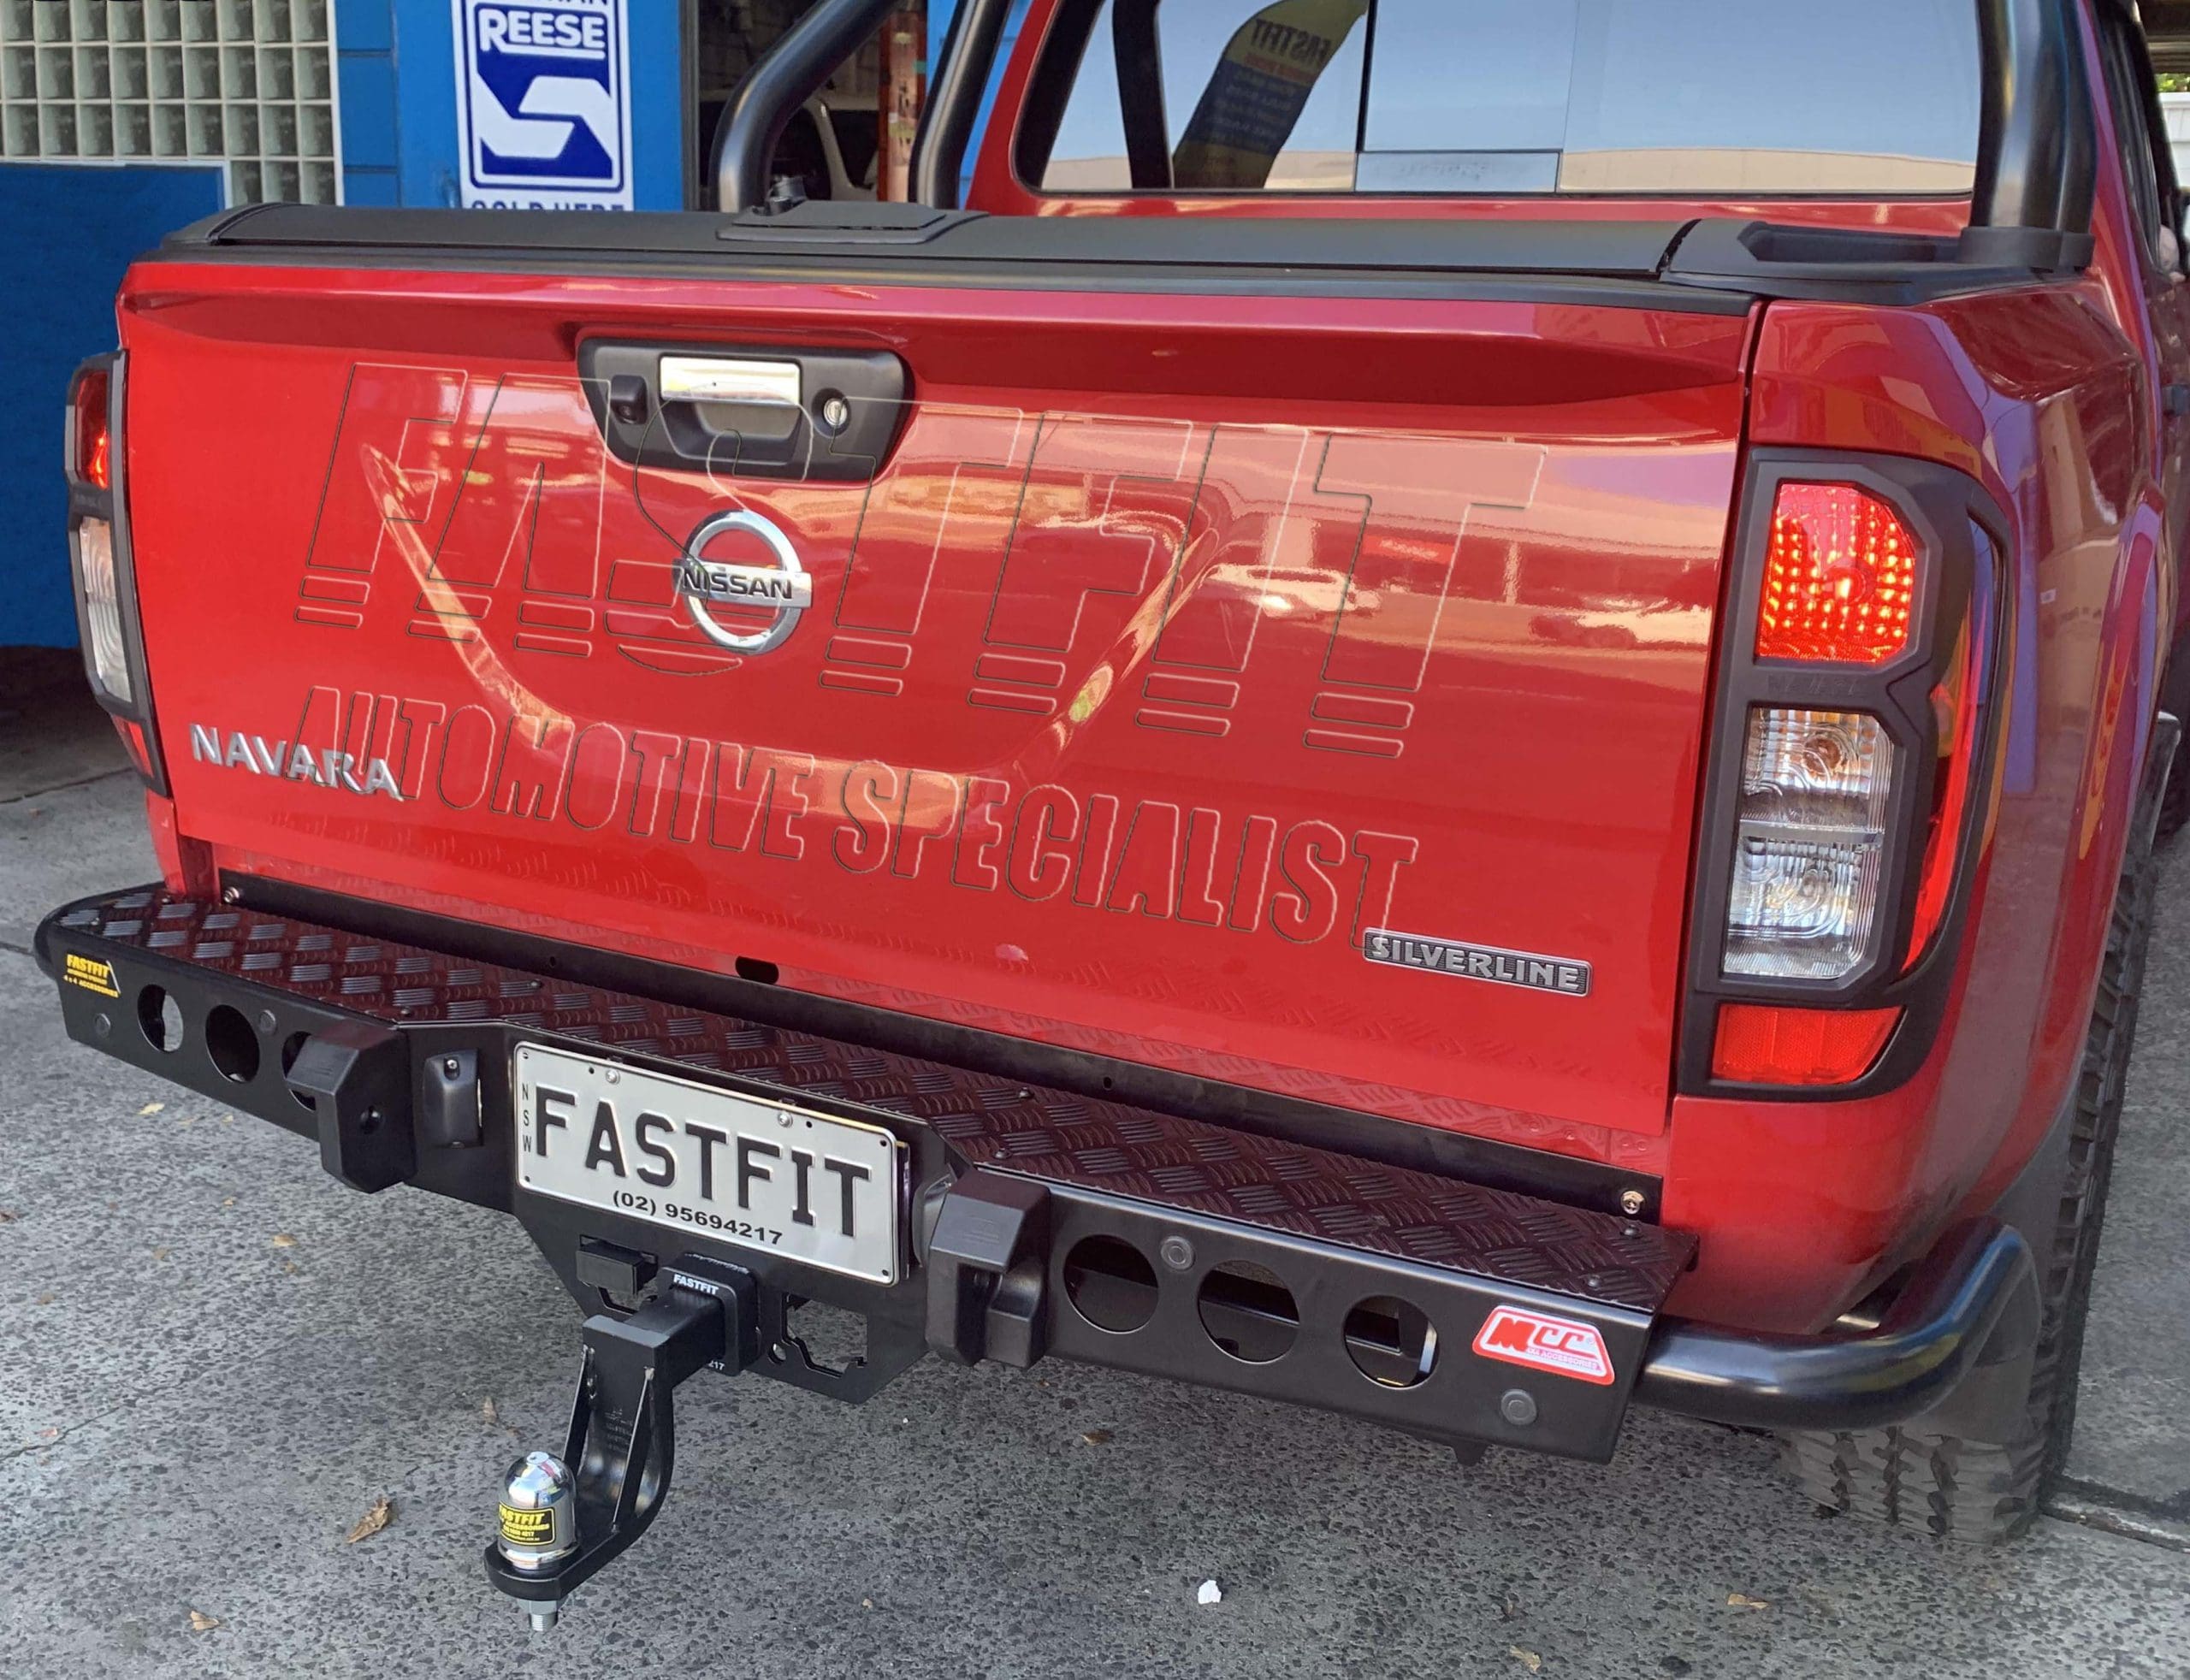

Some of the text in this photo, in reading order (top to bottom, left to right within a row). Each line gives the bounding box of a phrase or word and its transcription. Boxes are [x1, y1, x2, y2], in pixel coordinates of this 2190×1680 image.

[478, 9, 606, 59] REESE
[683, 570, 793, 600] NISSAN
[189, 723, 404, 802] NAVARA
[67, 953, 110, 979] FASTFIT
[1371, 936, 1580, 991] SILVERLINE
[536, 1084, 872, 1238] FASTFIT
[613, 1190, 783, 1245] (02) 95694217
[673, 1274, 719, 1295] FASTFIT
[1486, 1316, 1598, 1359] MCC
